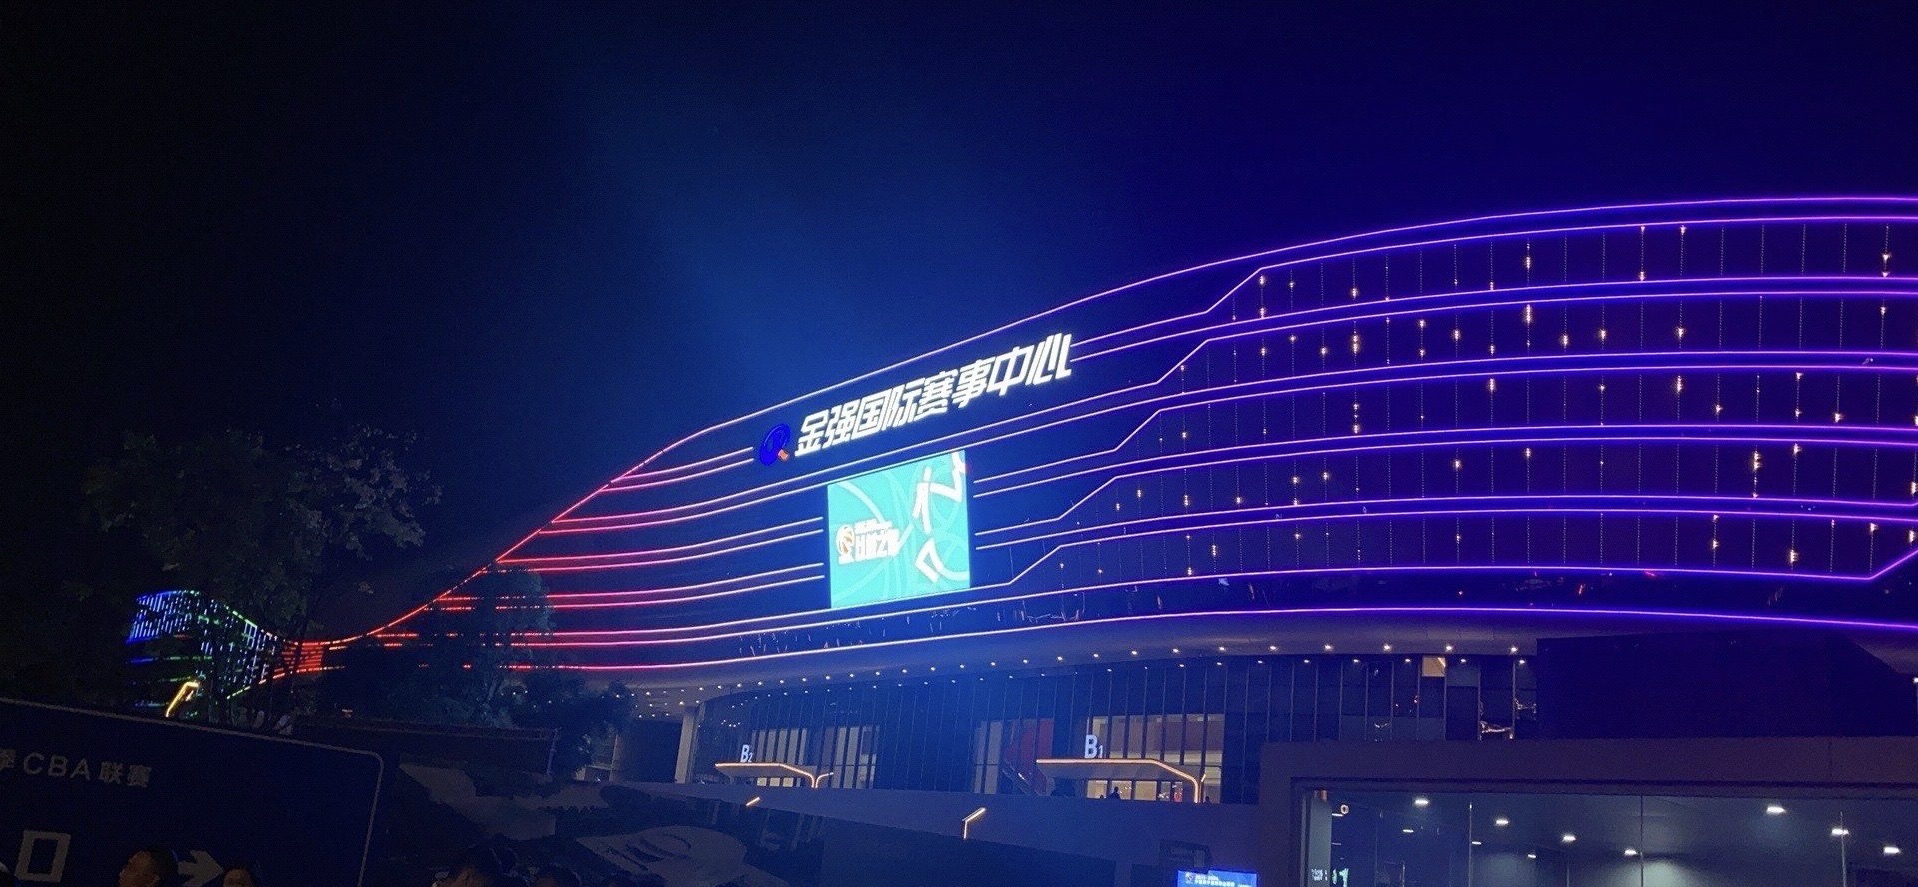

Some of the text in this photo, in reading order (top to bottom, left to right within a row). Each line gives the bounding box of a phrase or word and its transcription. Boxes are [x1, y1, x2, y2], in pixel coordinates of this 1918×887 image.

[794, 332, 1073, 457] 金强国际赛事中心
[740, 744, 754, 763] B2
[1084, 734, 1104, 759] B1
